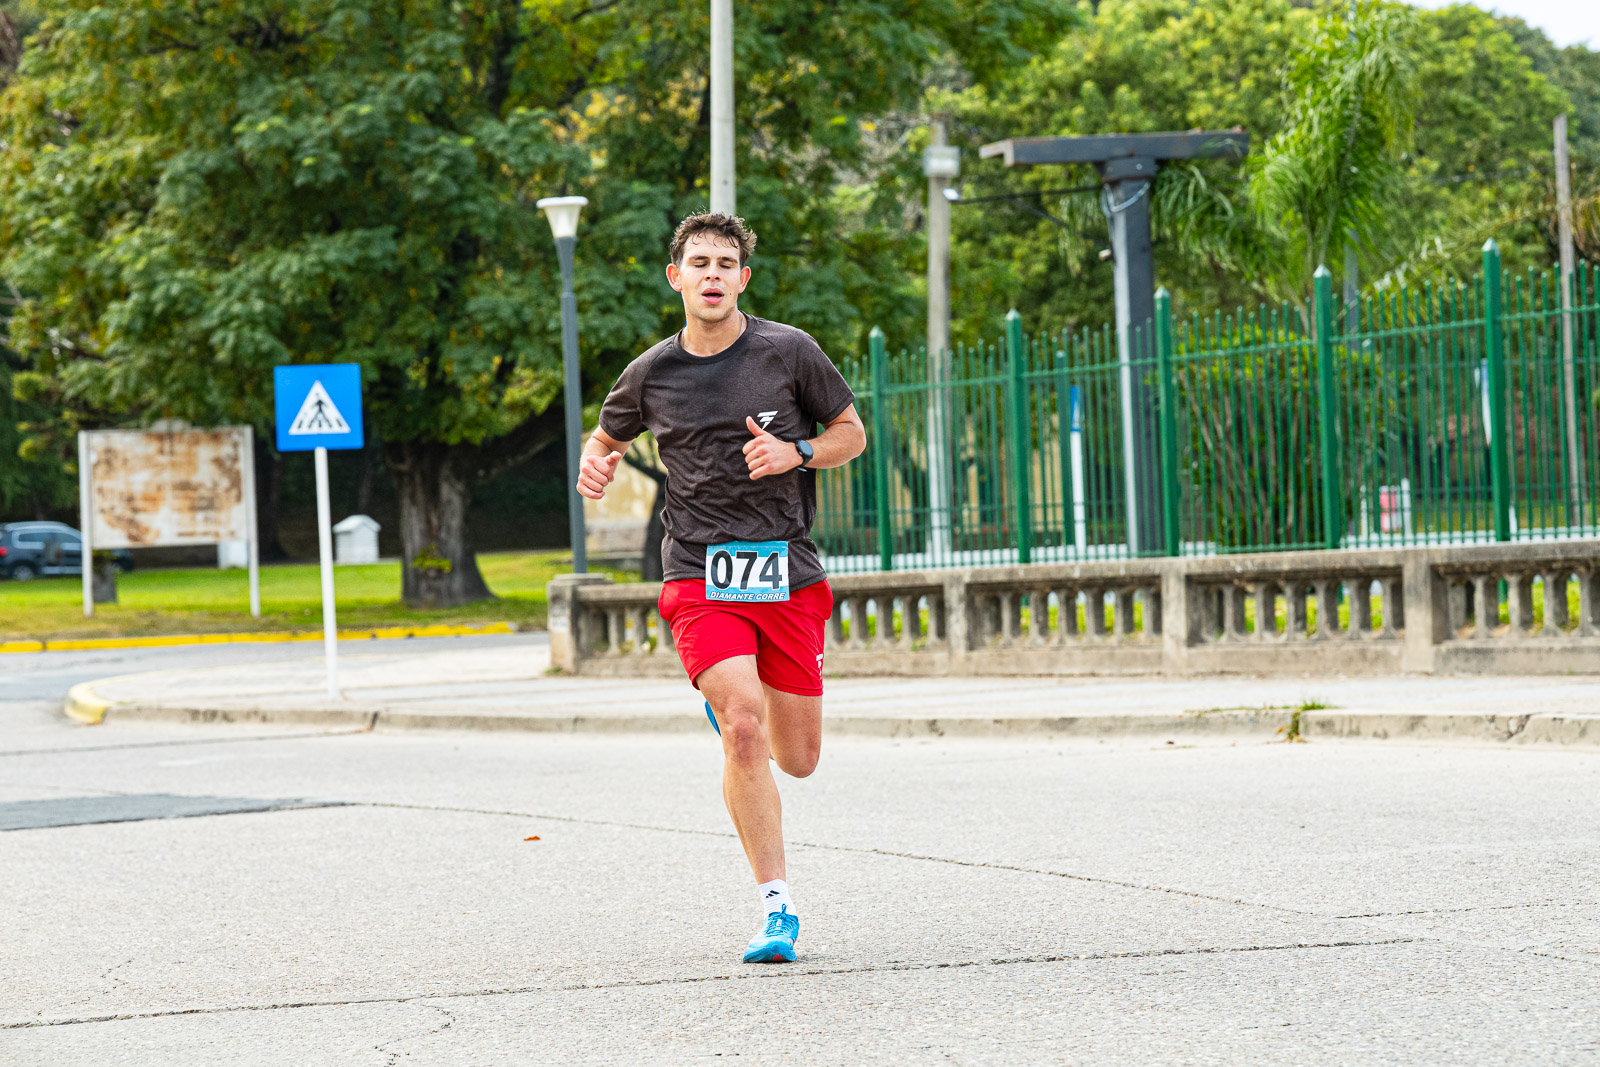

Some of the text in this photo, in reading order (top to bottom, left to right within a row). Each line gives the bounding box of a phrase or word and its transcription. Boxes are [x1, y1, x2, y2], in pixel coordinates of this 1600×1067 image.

[710, 549, 783, 590] 074
[710, 591, 785, 600] DIAMANTE CORRE
